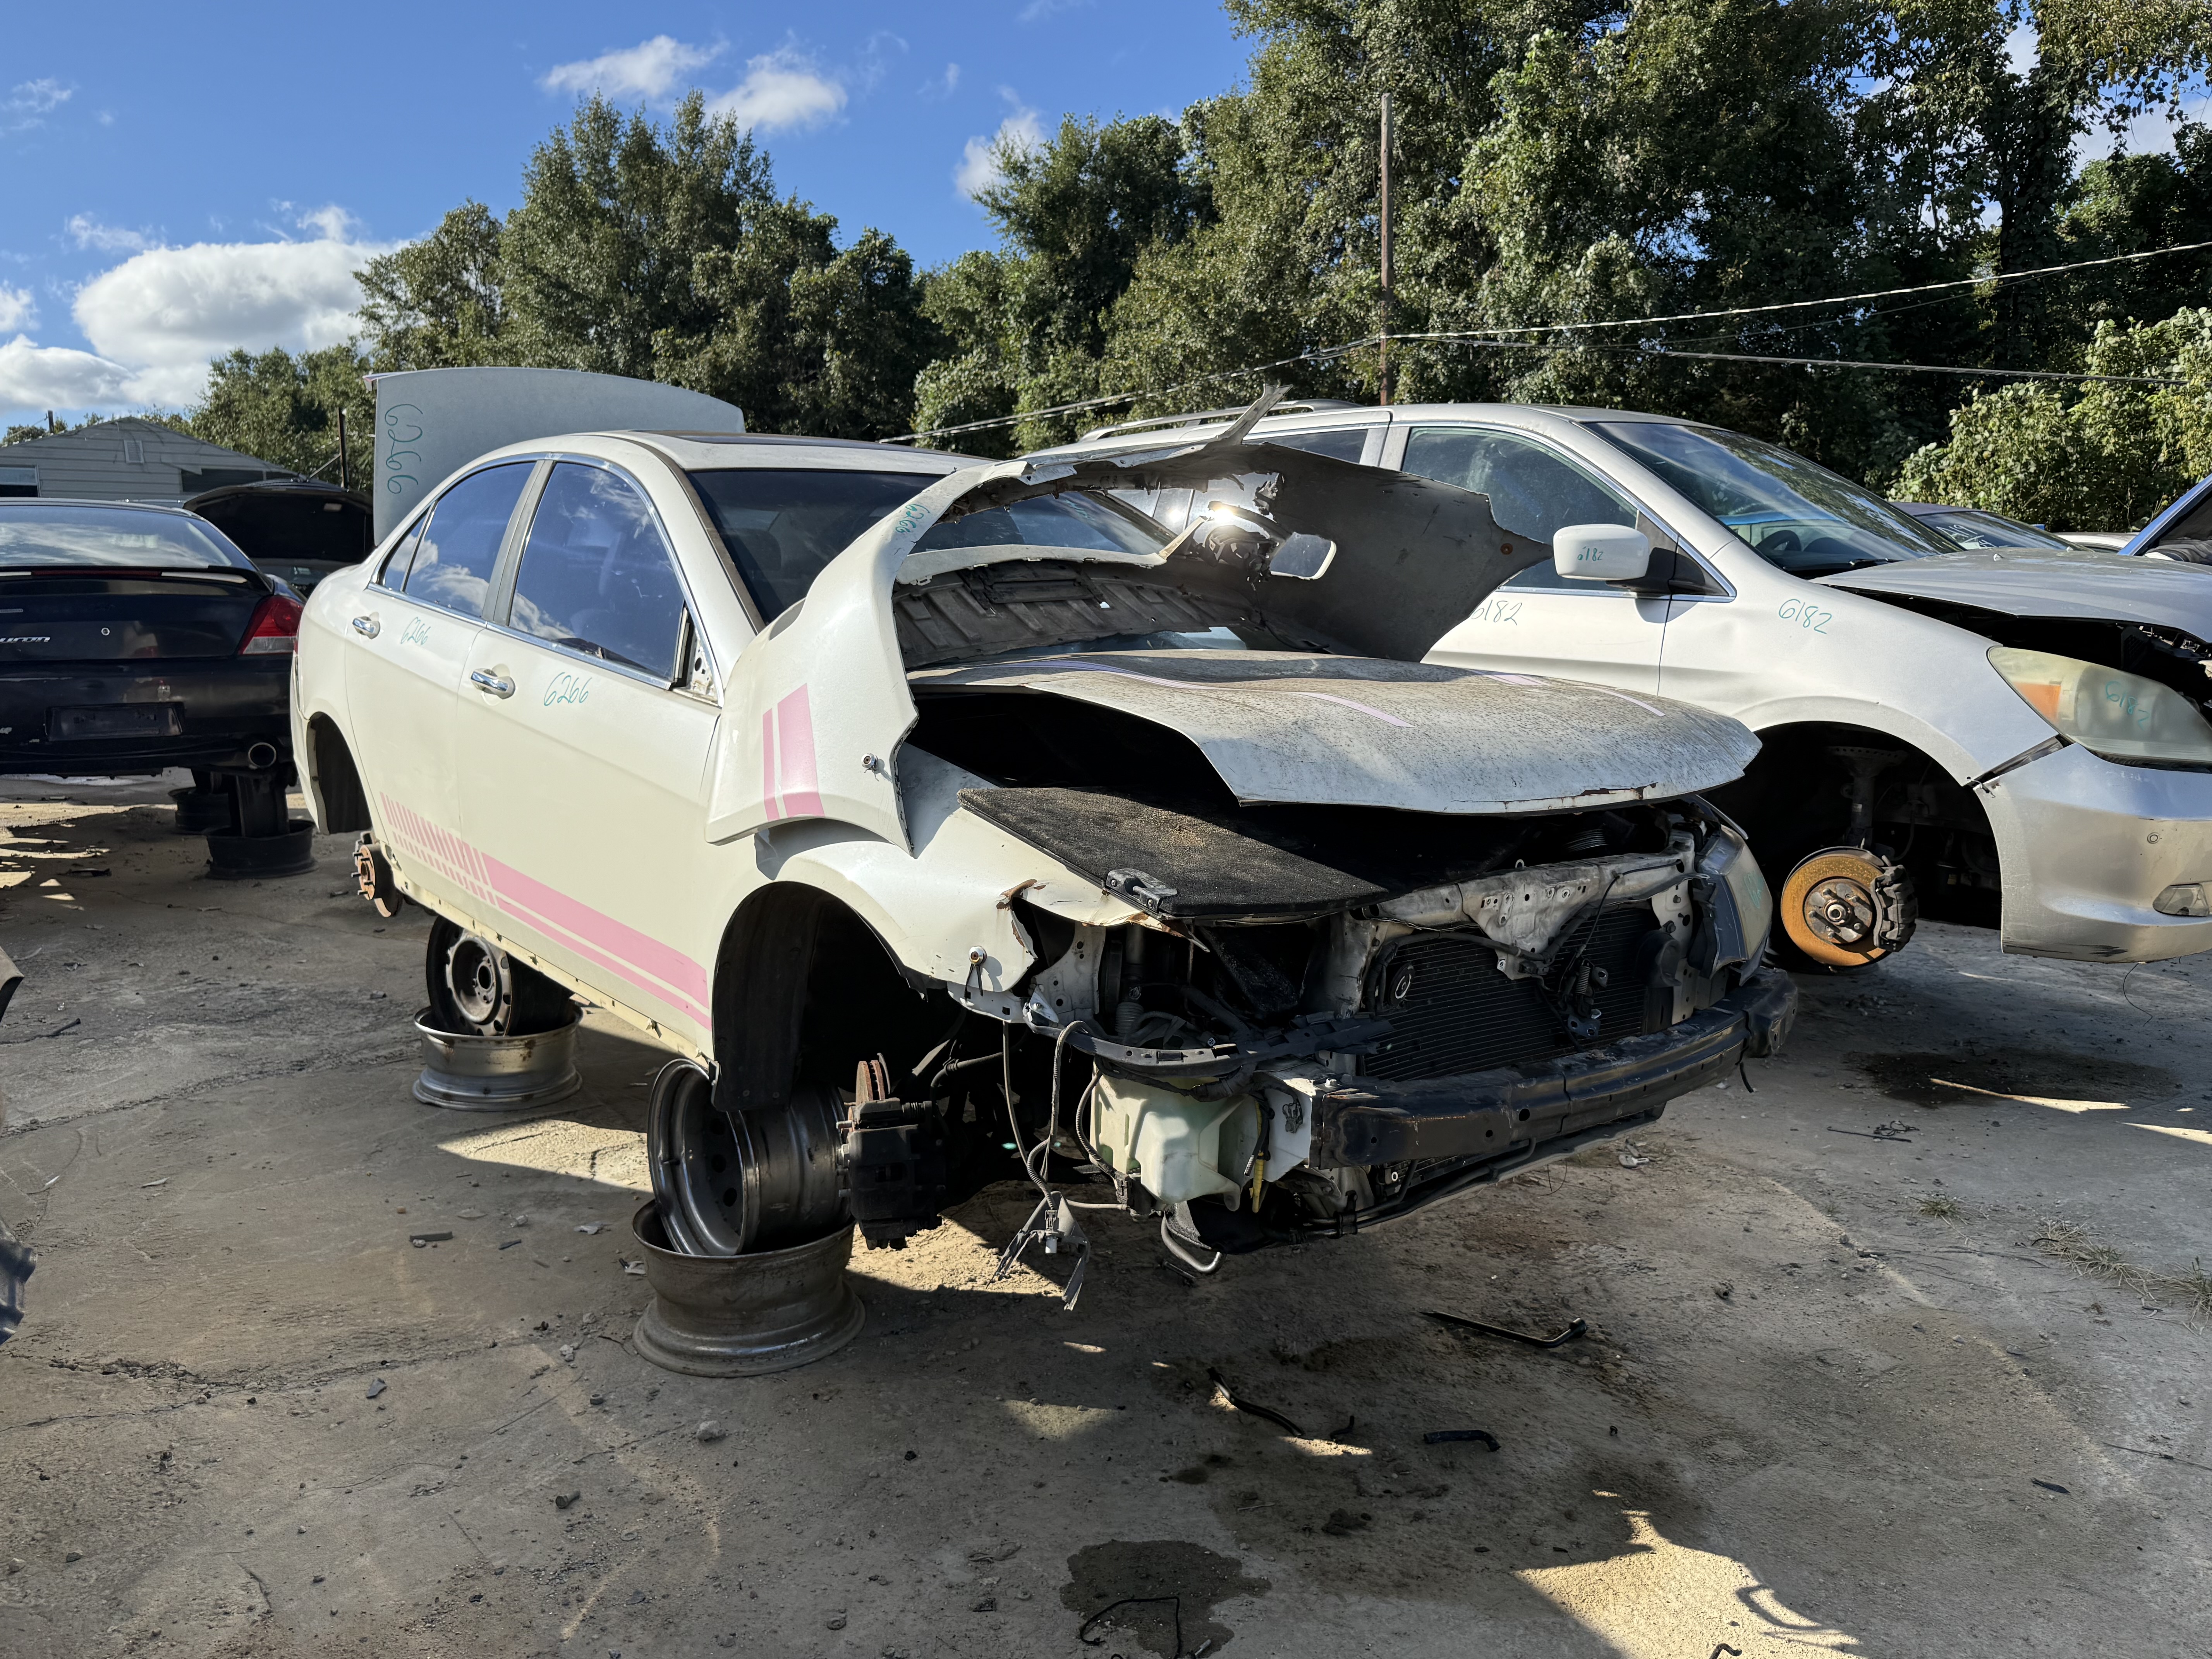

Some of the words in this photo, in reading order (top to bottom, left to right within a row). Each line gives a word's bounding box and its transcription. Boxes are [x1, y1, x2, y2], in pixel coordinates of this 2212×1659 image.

[385, 404, 423, 494] 6266
[895, 503, 930, 533] 6266
[400, 617, 431, 646] 6266
[1778, 598, 1832, 634] 6182
[543, 672, 592, 706] 6266
[2106, 680, 2151, 732] 6182
